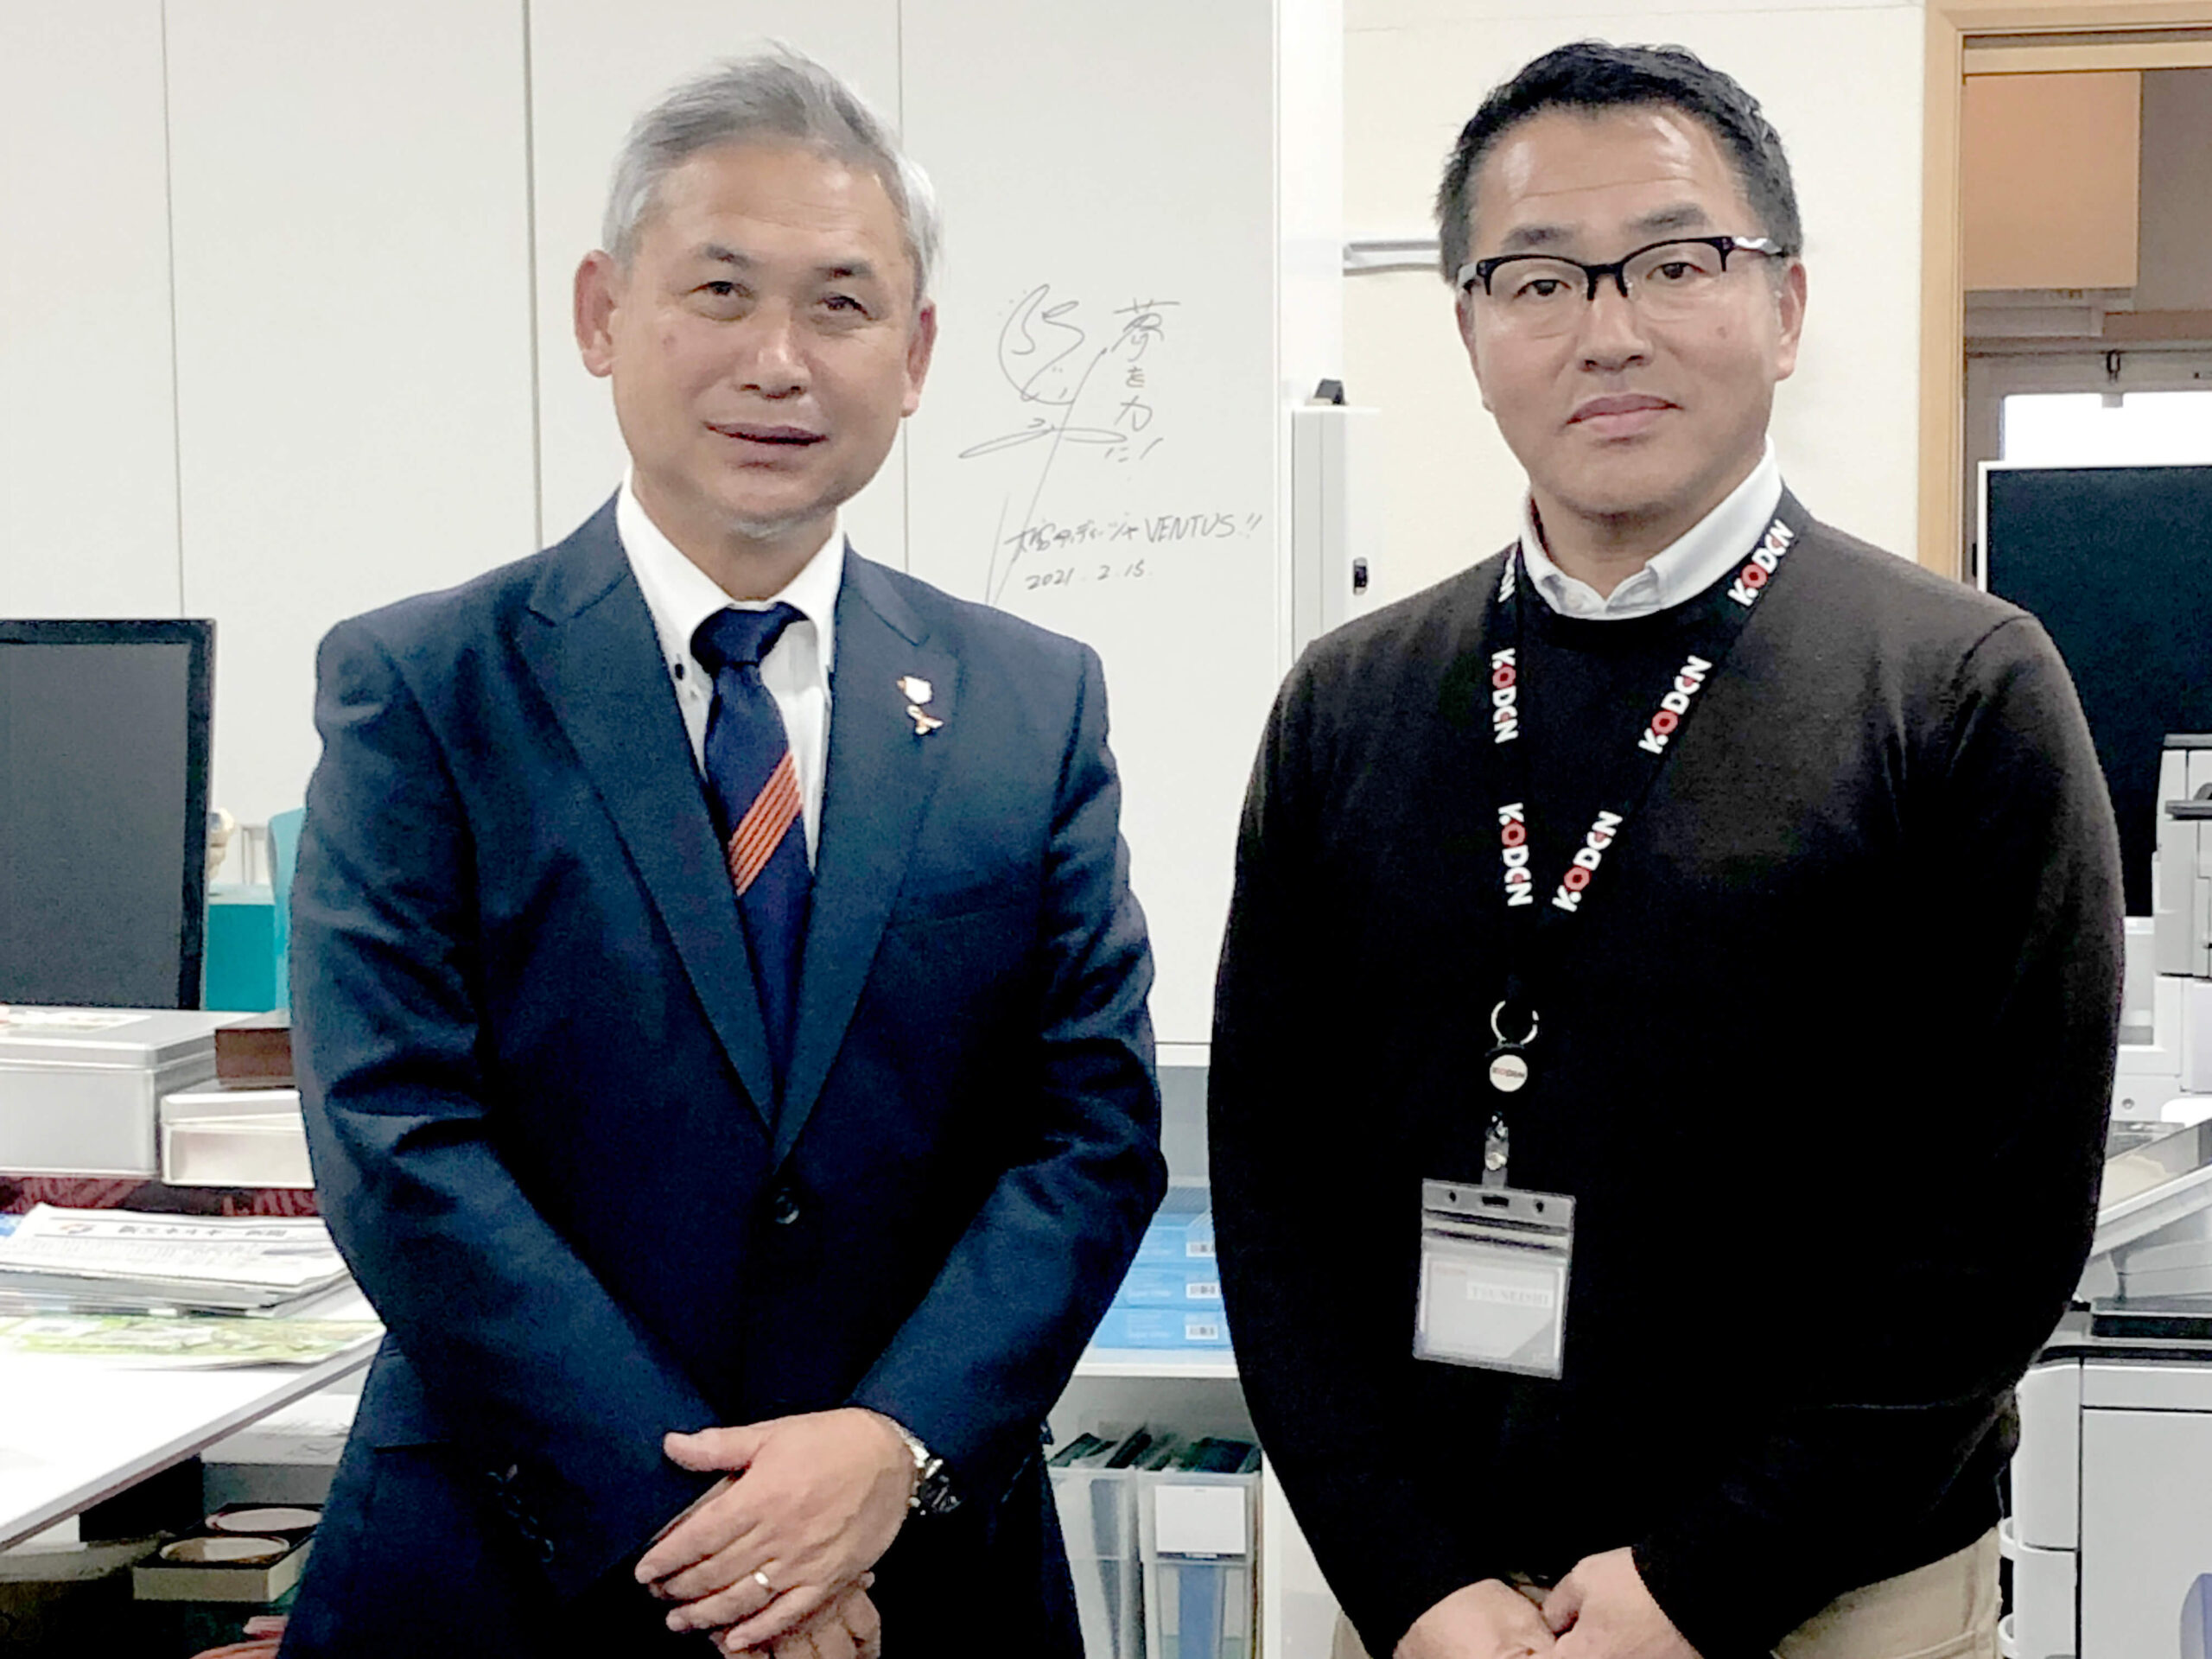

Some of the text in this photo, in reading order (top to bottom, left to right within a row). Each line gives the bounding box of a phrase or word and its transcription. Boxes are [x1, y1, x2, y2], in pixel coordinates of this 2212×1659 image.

[1727, 519, 1795, 607] KODEN
[1491, 648, 1518, 744] KODEN
[1638, 655, 1713, 754] KODEN
[1498, 803, 1533, 906] KODEN
[1552, 810, 1623, 912] KODEN
